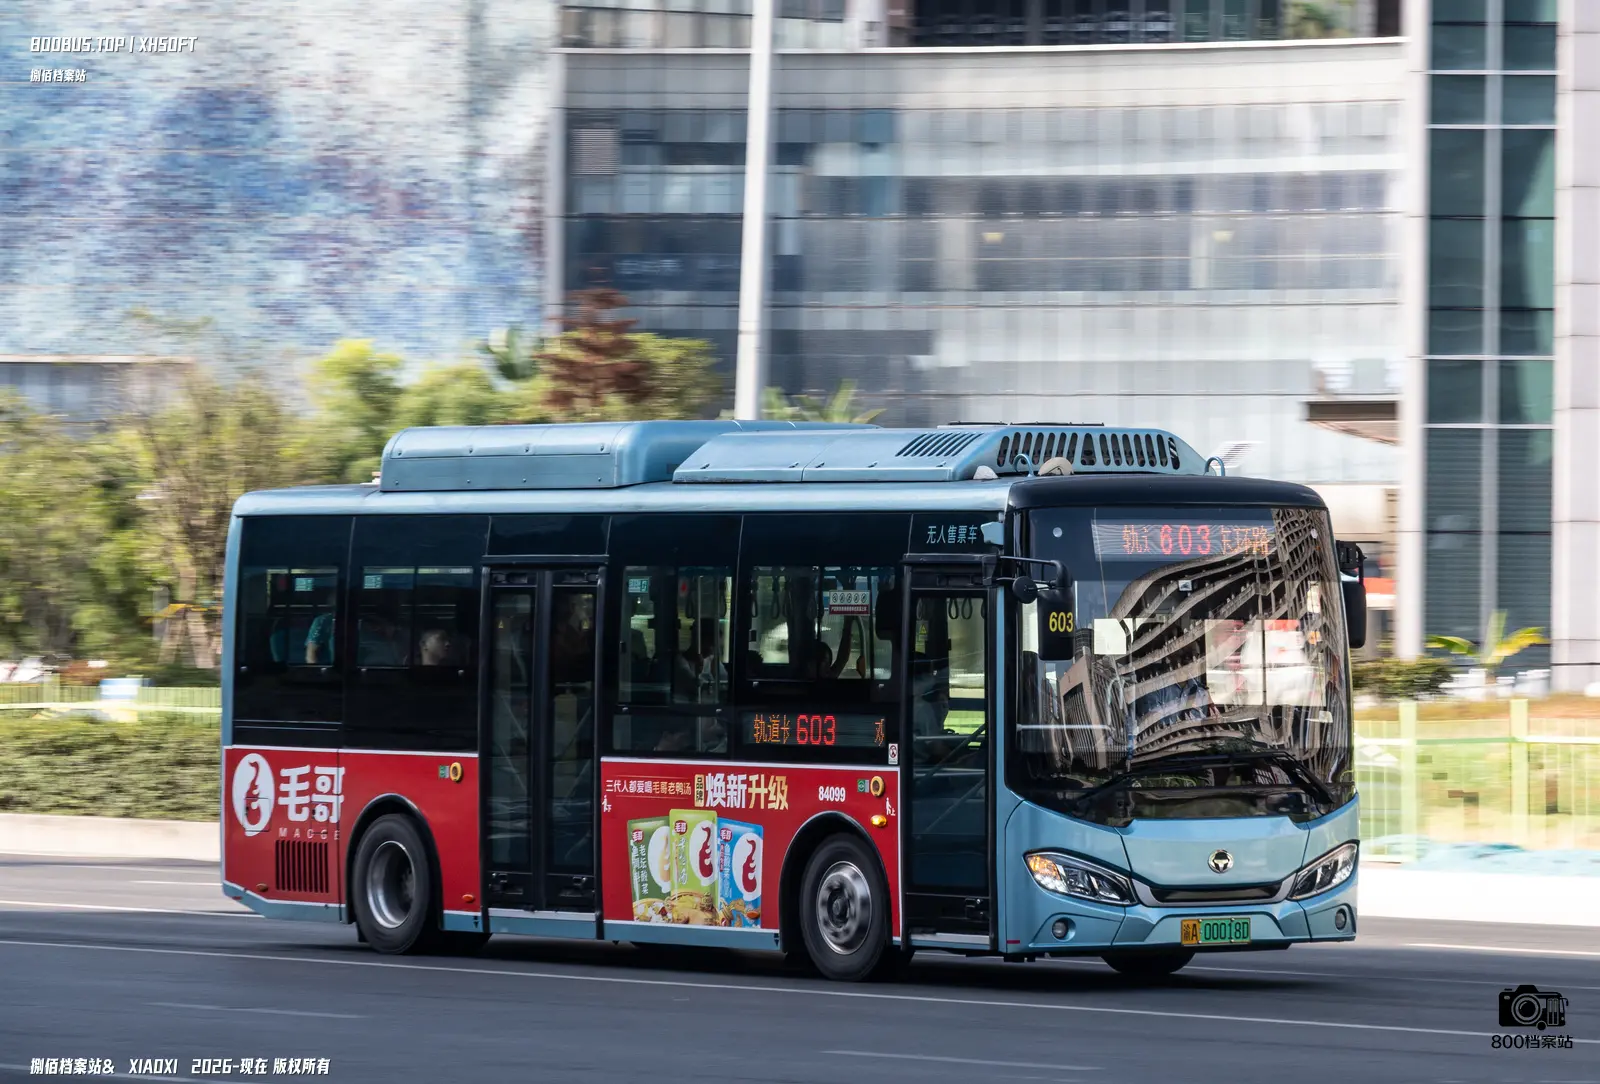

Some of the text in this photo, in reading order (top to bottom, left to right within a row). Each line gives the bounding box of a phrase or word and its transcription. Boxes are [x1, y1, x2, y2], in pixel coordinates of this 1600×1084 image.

[926, 524, 978, 544] 无人售票车
[1159, 524, 1211, 555] 603
[1049, 611, 1074, 633] 603
[796, 714, 836, 745] 603
[277, 764, 346, 824] 毛哥
[605, 779, 692, 796] 三代人都爱喝毛哥老鸭汤
[705, 772, 789, 811] 焕新升级
[818, 783, 846, 803] 84099
[1204, 921, 1249, 941] 00018D
